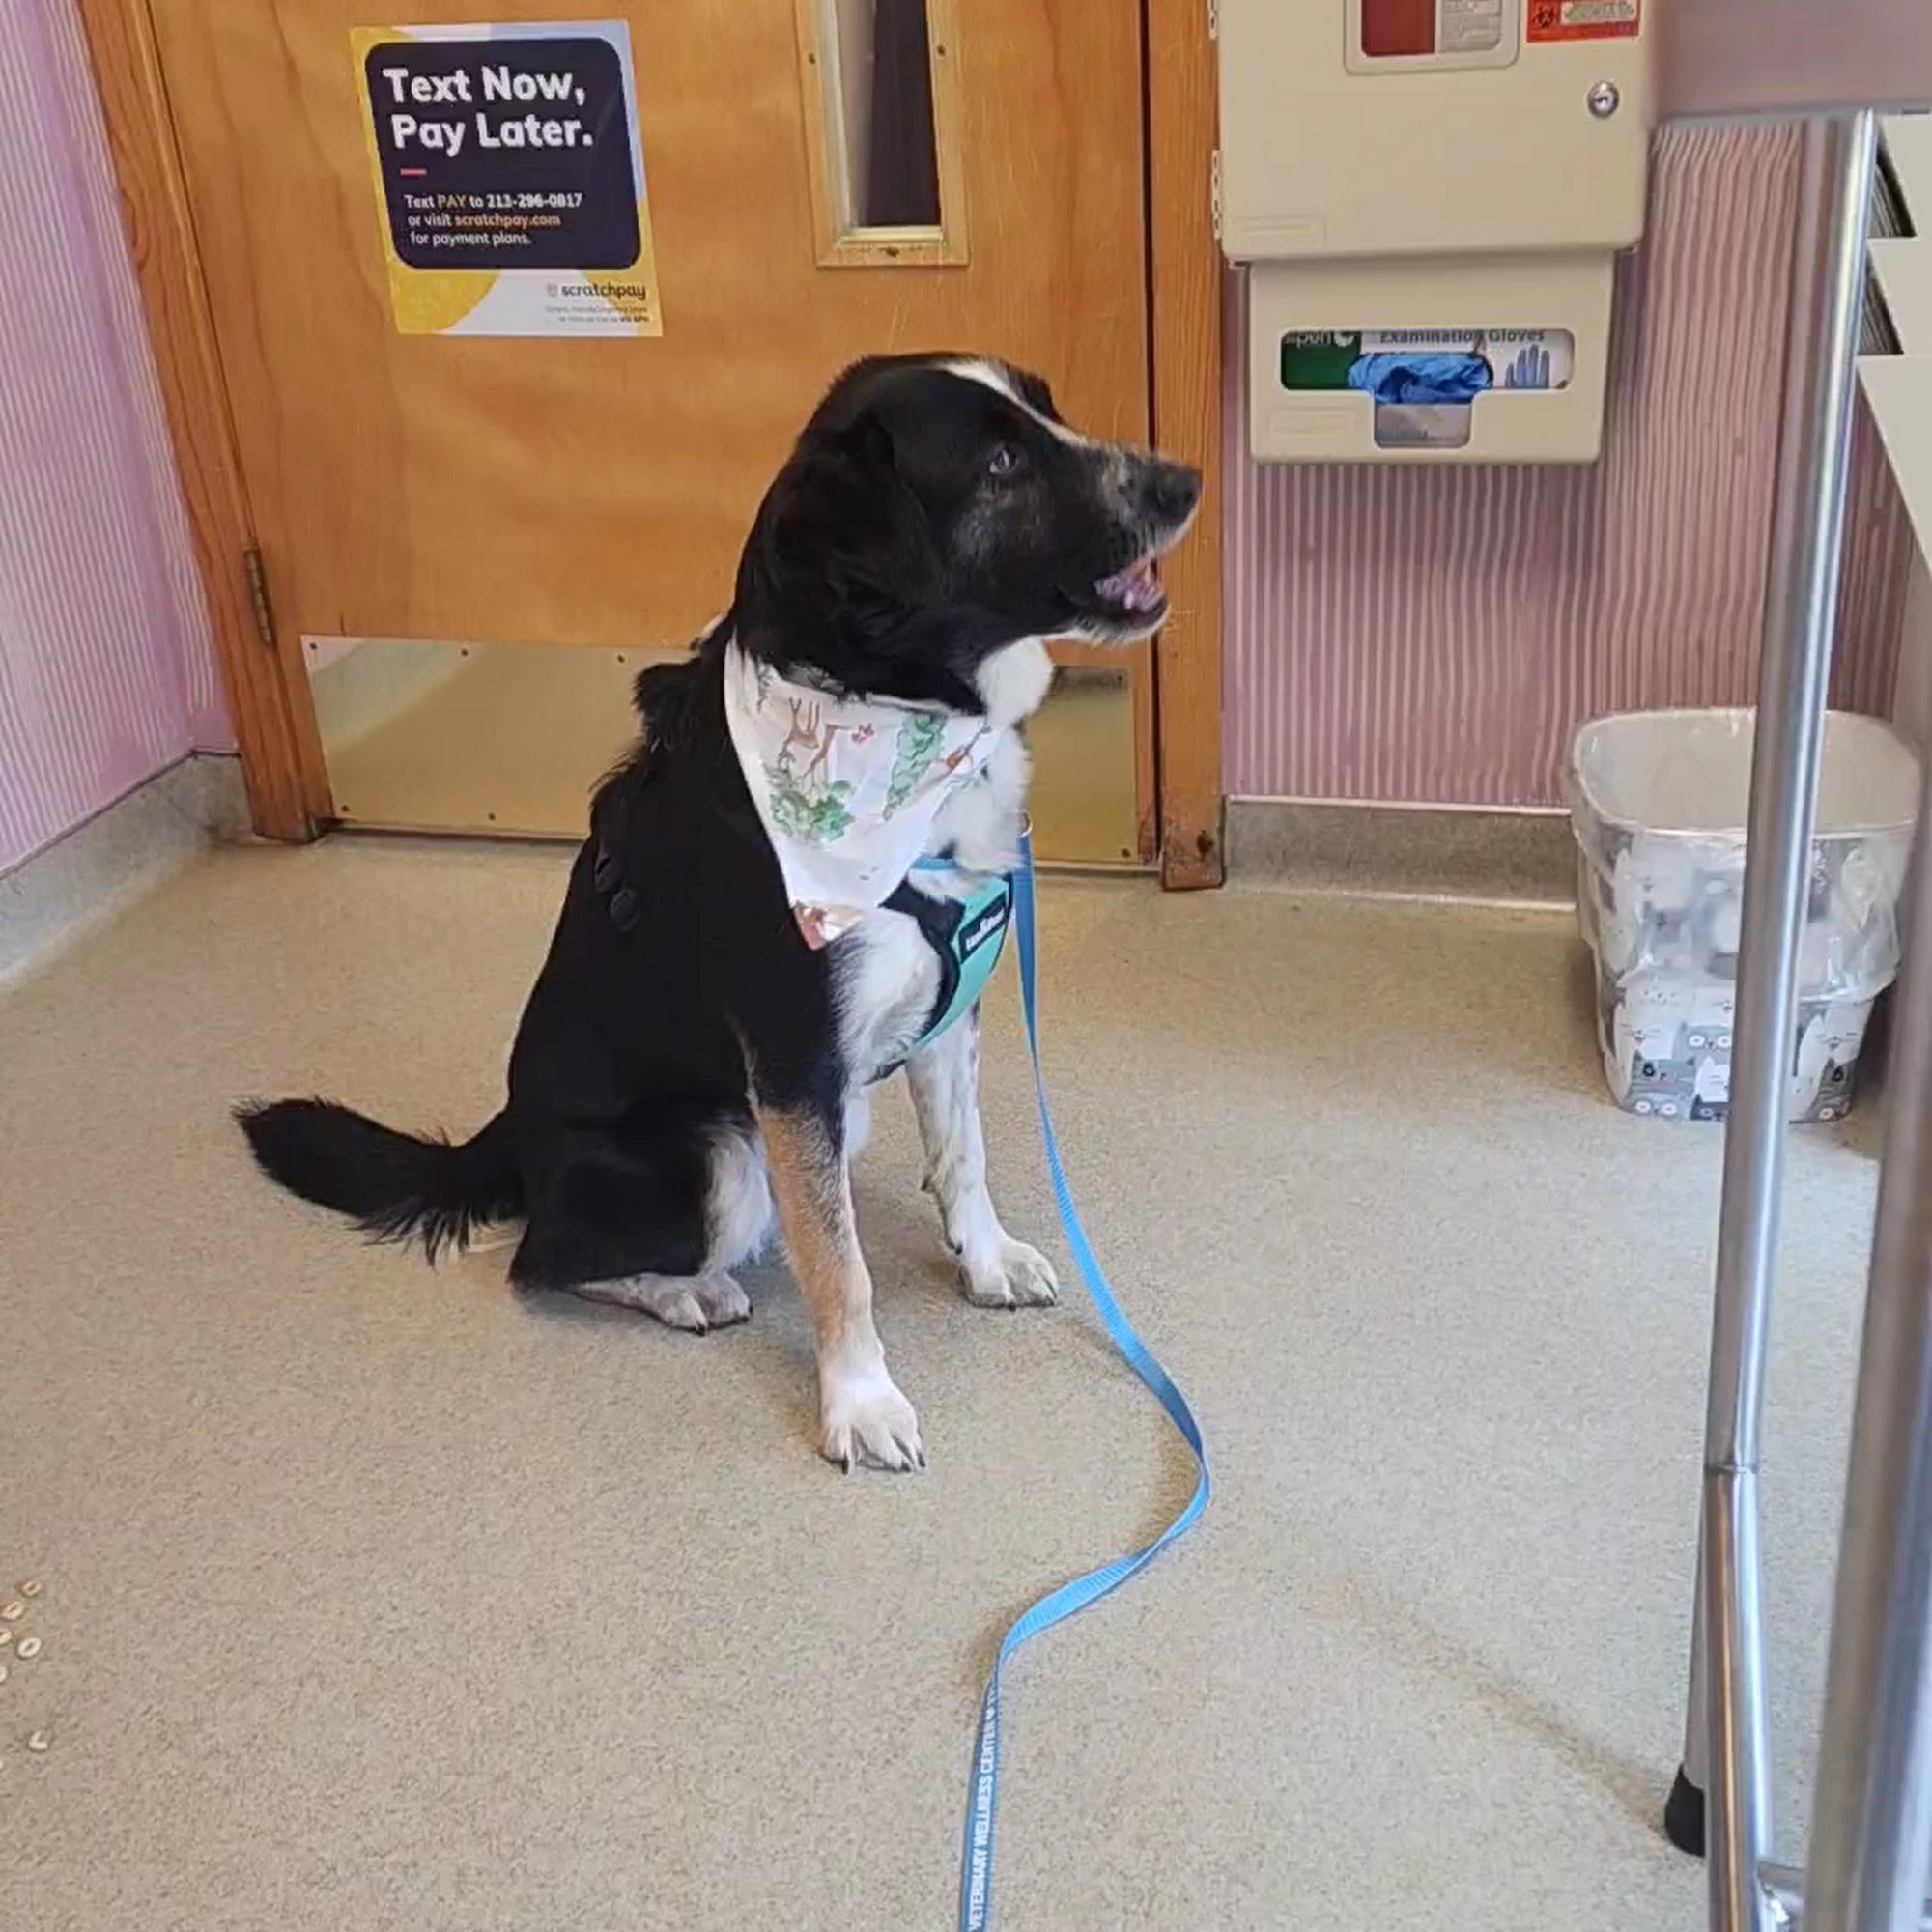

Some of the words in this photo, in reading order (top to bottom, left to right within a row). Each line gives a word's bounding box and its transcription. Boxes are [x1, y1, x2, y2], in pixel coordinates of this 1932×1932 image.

[383, 67, 472, 102] Text
[482, 66, 585, 106] Now,
[391, 114, 466, 157] Pay
[475, 112, 593, 147] Later.
[404, 194, 434, 209] Text
[438, 194, 467, 208] PAY
[469, 194, 484, 209] to
[408, 215, 421, 226] or
[424, 213, 452, 226] visit
[455, 213, 561, 229] scratchpay.com
[410, 232, 429, 245] for
[432, 233, 491, 247] payment
[492, 231, 532, 246] plans.
[561, 281, 646, 301] scratchpay
[1489, 328, 1546, 343] Gloves
